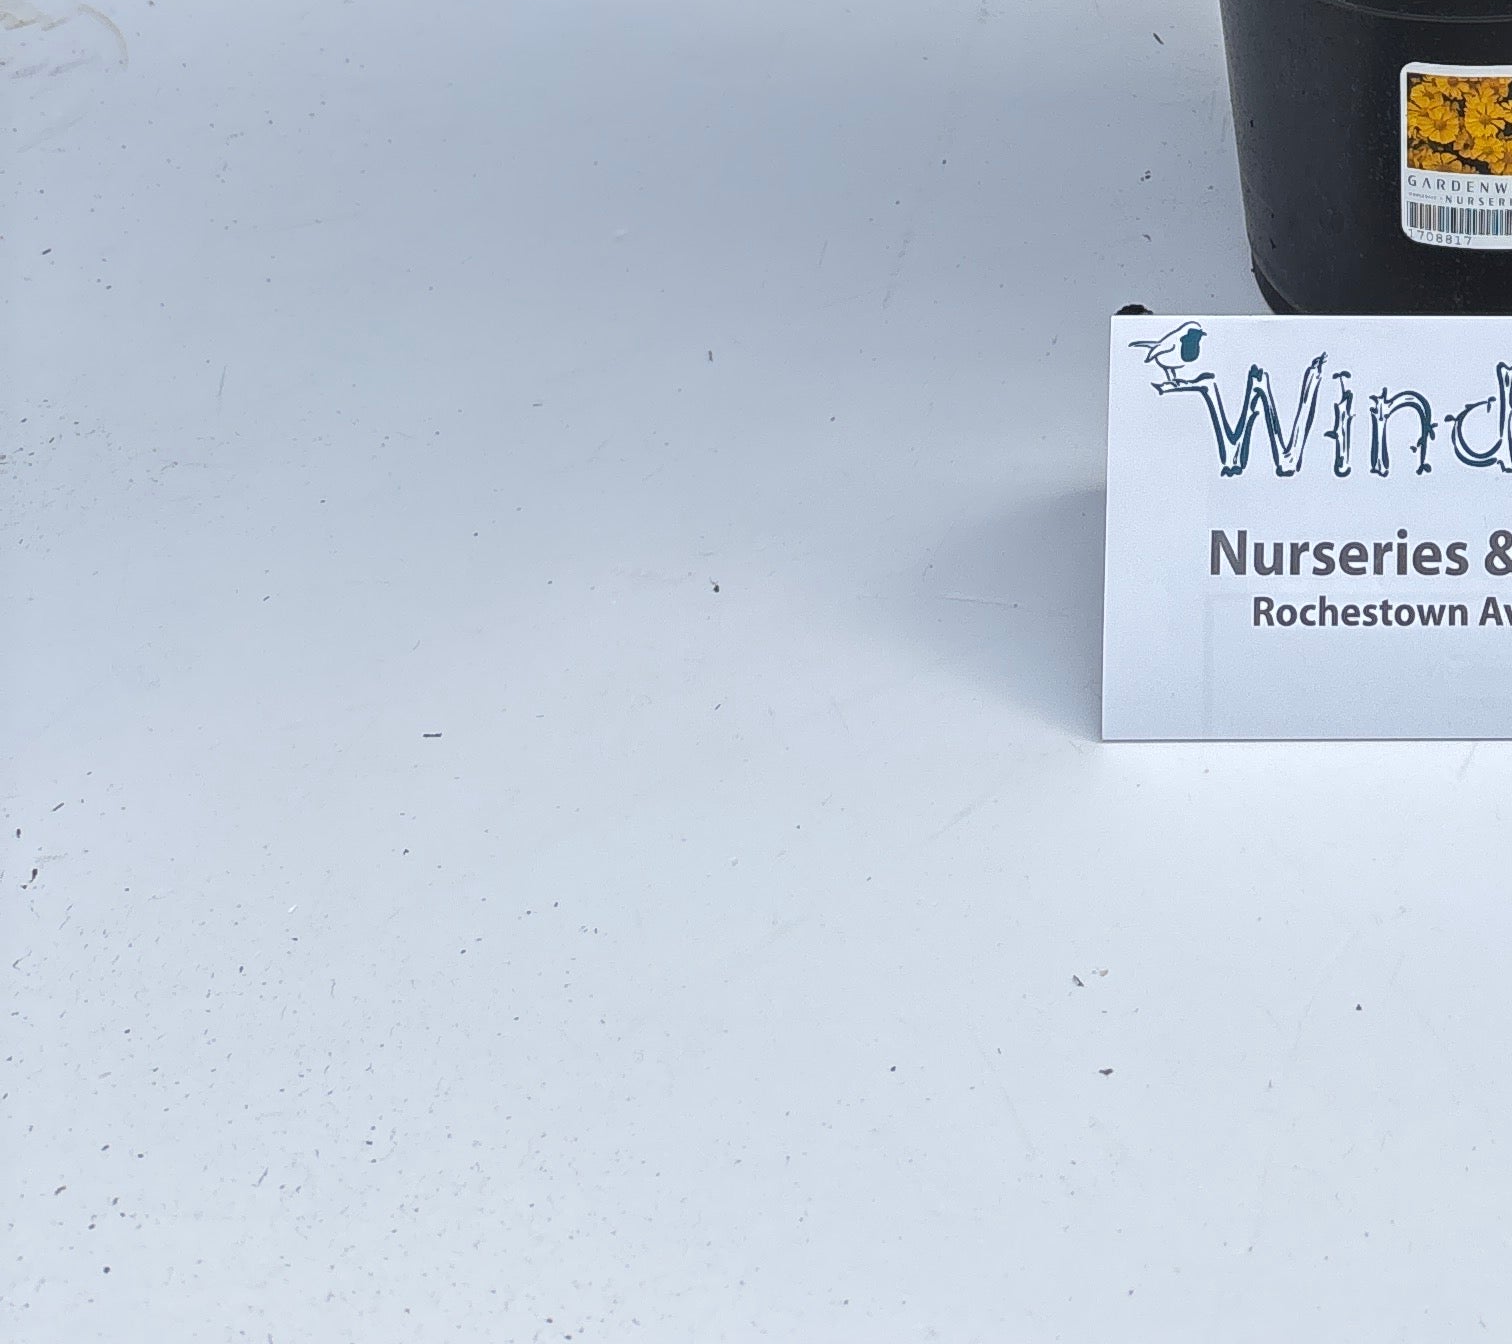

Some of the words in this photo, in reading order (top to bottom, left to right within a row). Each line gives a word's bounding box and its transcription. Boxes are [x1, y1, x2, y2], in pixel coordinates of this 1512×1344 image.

[1407, 227, 1473, 246] 1708817
[1208, 528, 1469, 578] Nurseries
[1251, 596, 1469, 629] Rochestown
